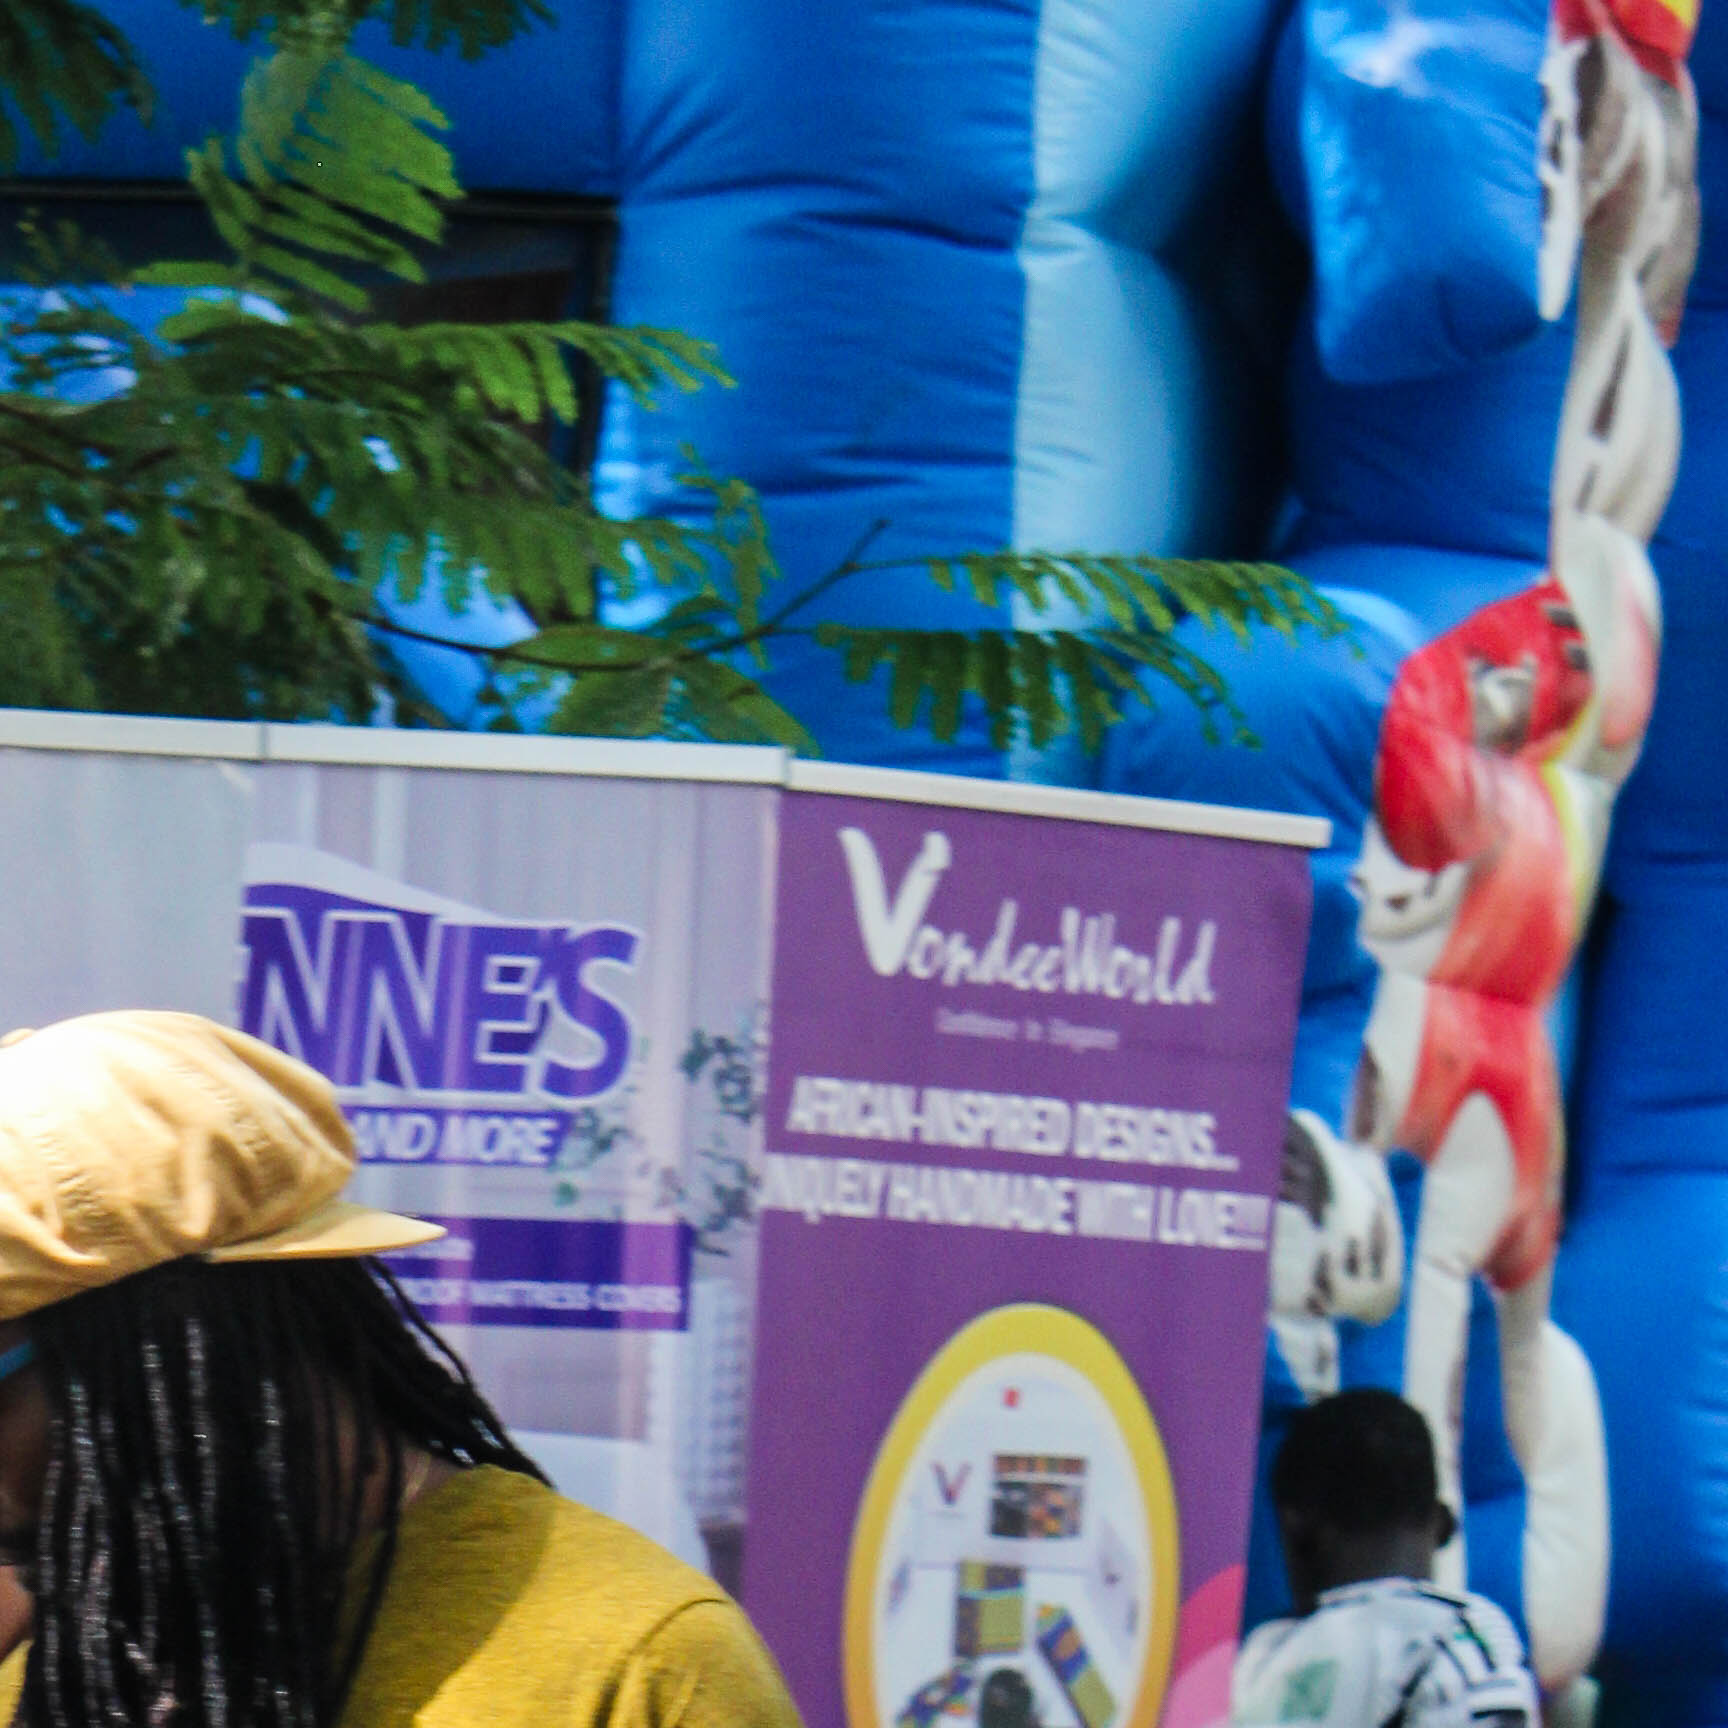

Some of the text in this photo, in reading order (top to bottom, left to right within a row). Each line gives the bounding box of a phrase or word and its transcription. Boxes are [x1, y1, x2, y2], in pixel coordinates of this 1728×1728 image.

[238, 907, 640, 1103] NNE'S
[437, 1113, 559, 1164] MORE
[764, 1153, 884, 1224] NIQUELY
[886, 1161, 1075, 1235] HANDMADE
[1078, 1180, 1154, 1242] WITH
